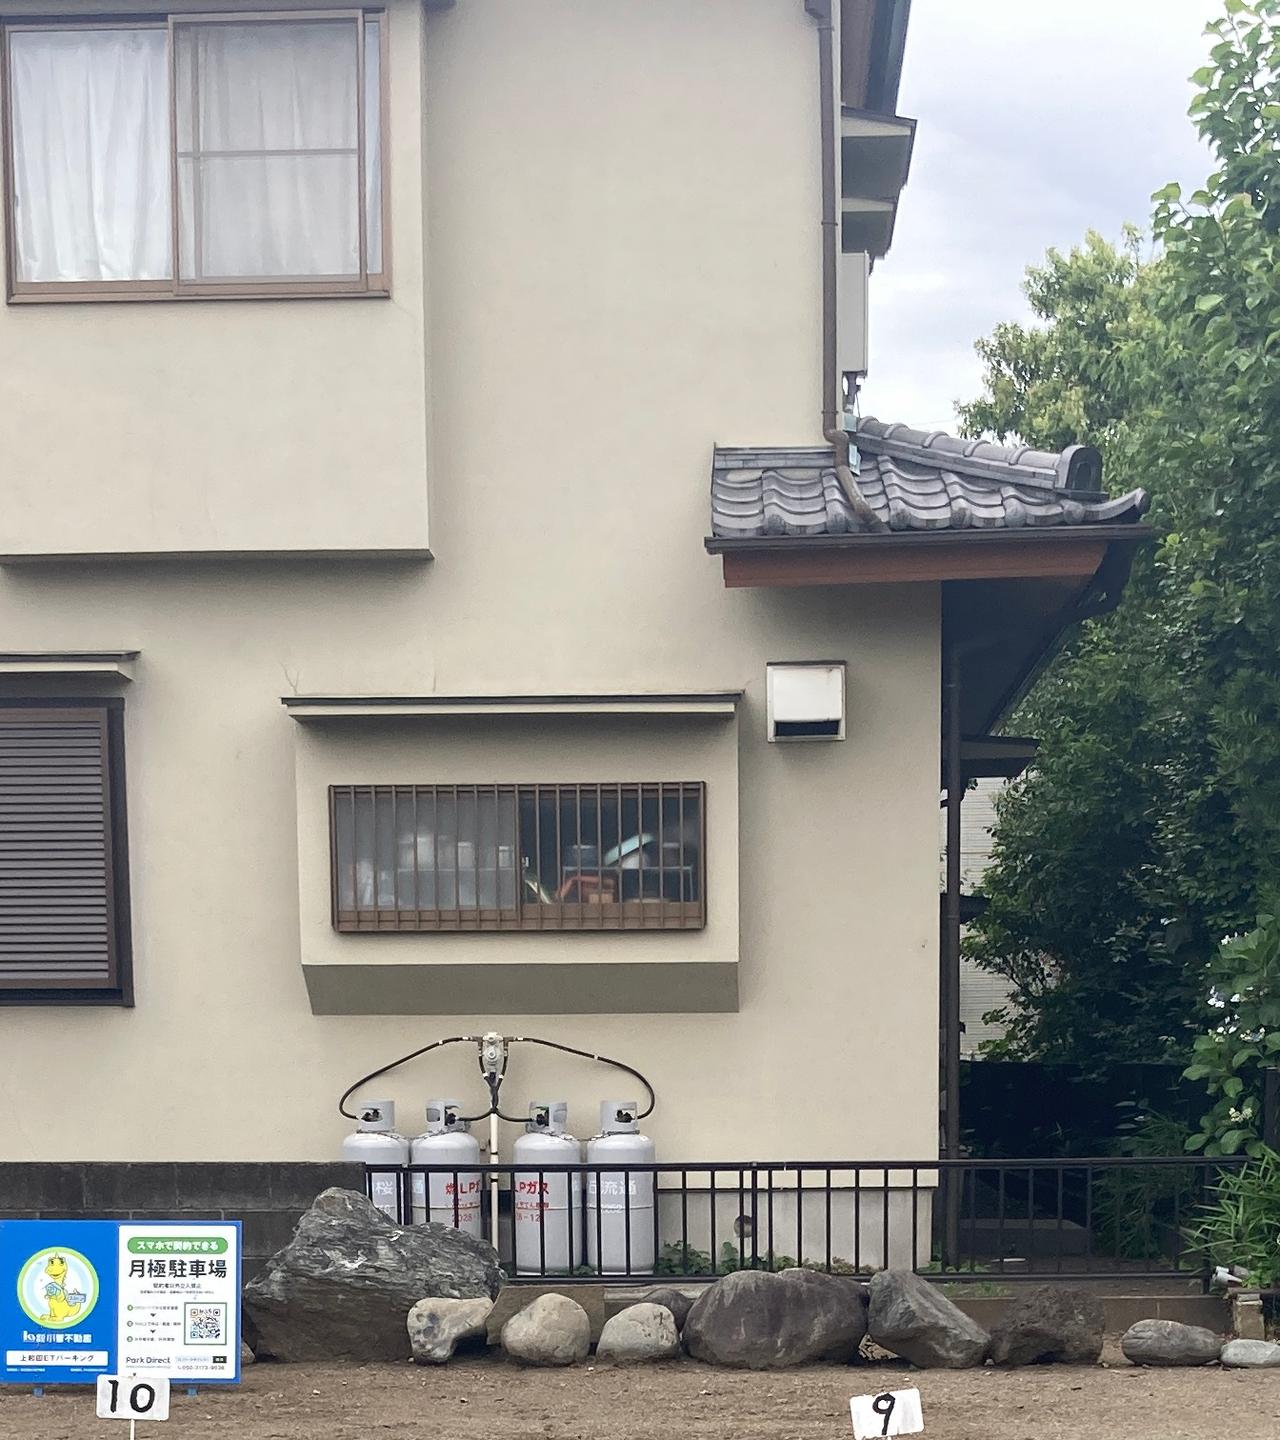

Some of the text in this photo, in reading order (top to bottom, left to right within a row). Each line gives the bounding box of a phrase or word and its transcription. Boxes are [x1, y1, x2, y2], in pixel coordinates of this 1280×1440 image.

[136, 1240, 218, 1251] スマホで契約できる
[128, 1259, 227, 1278] 月極駐車場
[126, 1356, 144, 1364] Park
[146, 1356, 171, 1364] Direct
[108, 1379, 156, 1413] 10
[872, 1393, 896, 1436] 9
